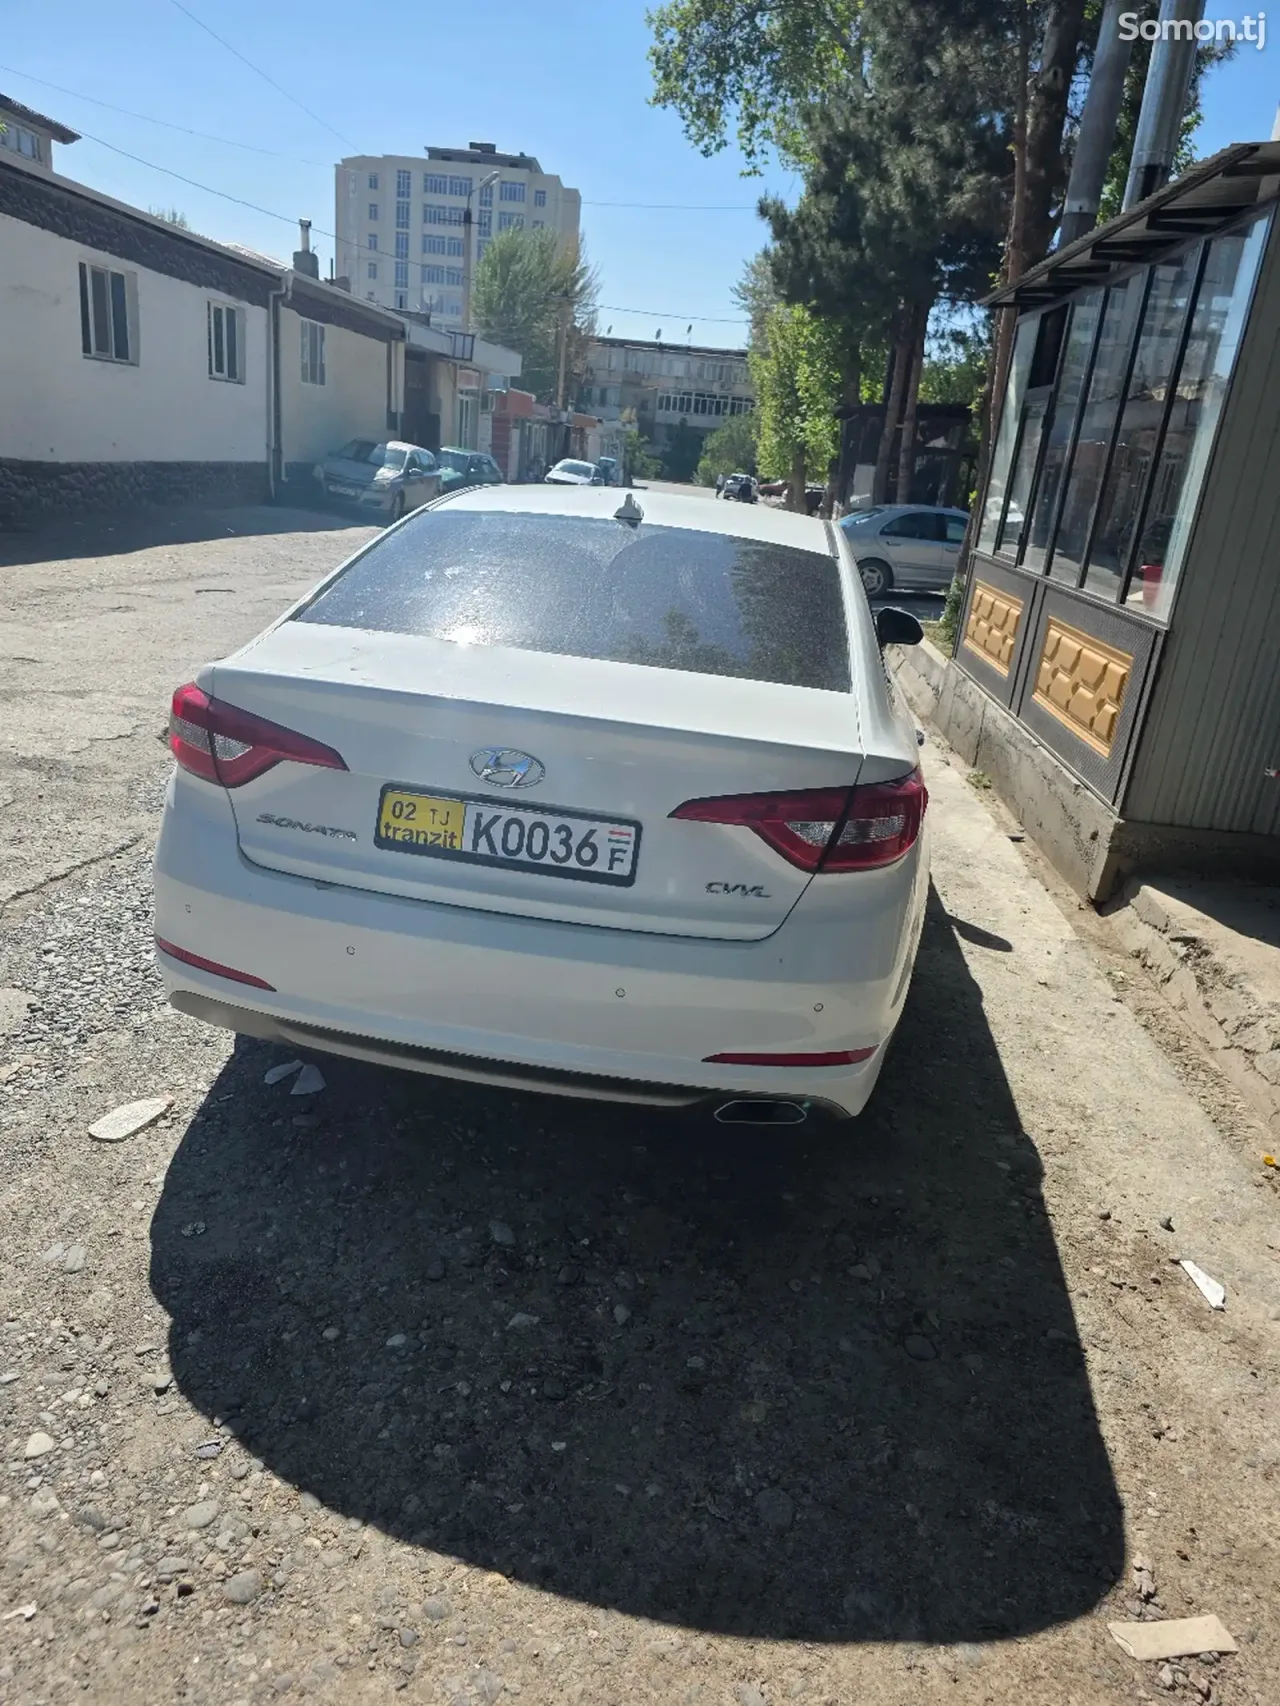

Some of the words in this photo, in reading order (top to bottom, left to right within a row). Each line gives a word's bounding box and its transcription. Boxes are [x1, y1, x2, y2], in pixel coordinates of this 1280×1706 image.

[392, 801, 417, 820] 02
[430, 808, 450, 826] TJ
[256, 814, 357, 841] SONATA
[383, 821, 457, 849] tranzit
[471, 812, 598, 867] K0036
[607, 847, 628, 871] F
